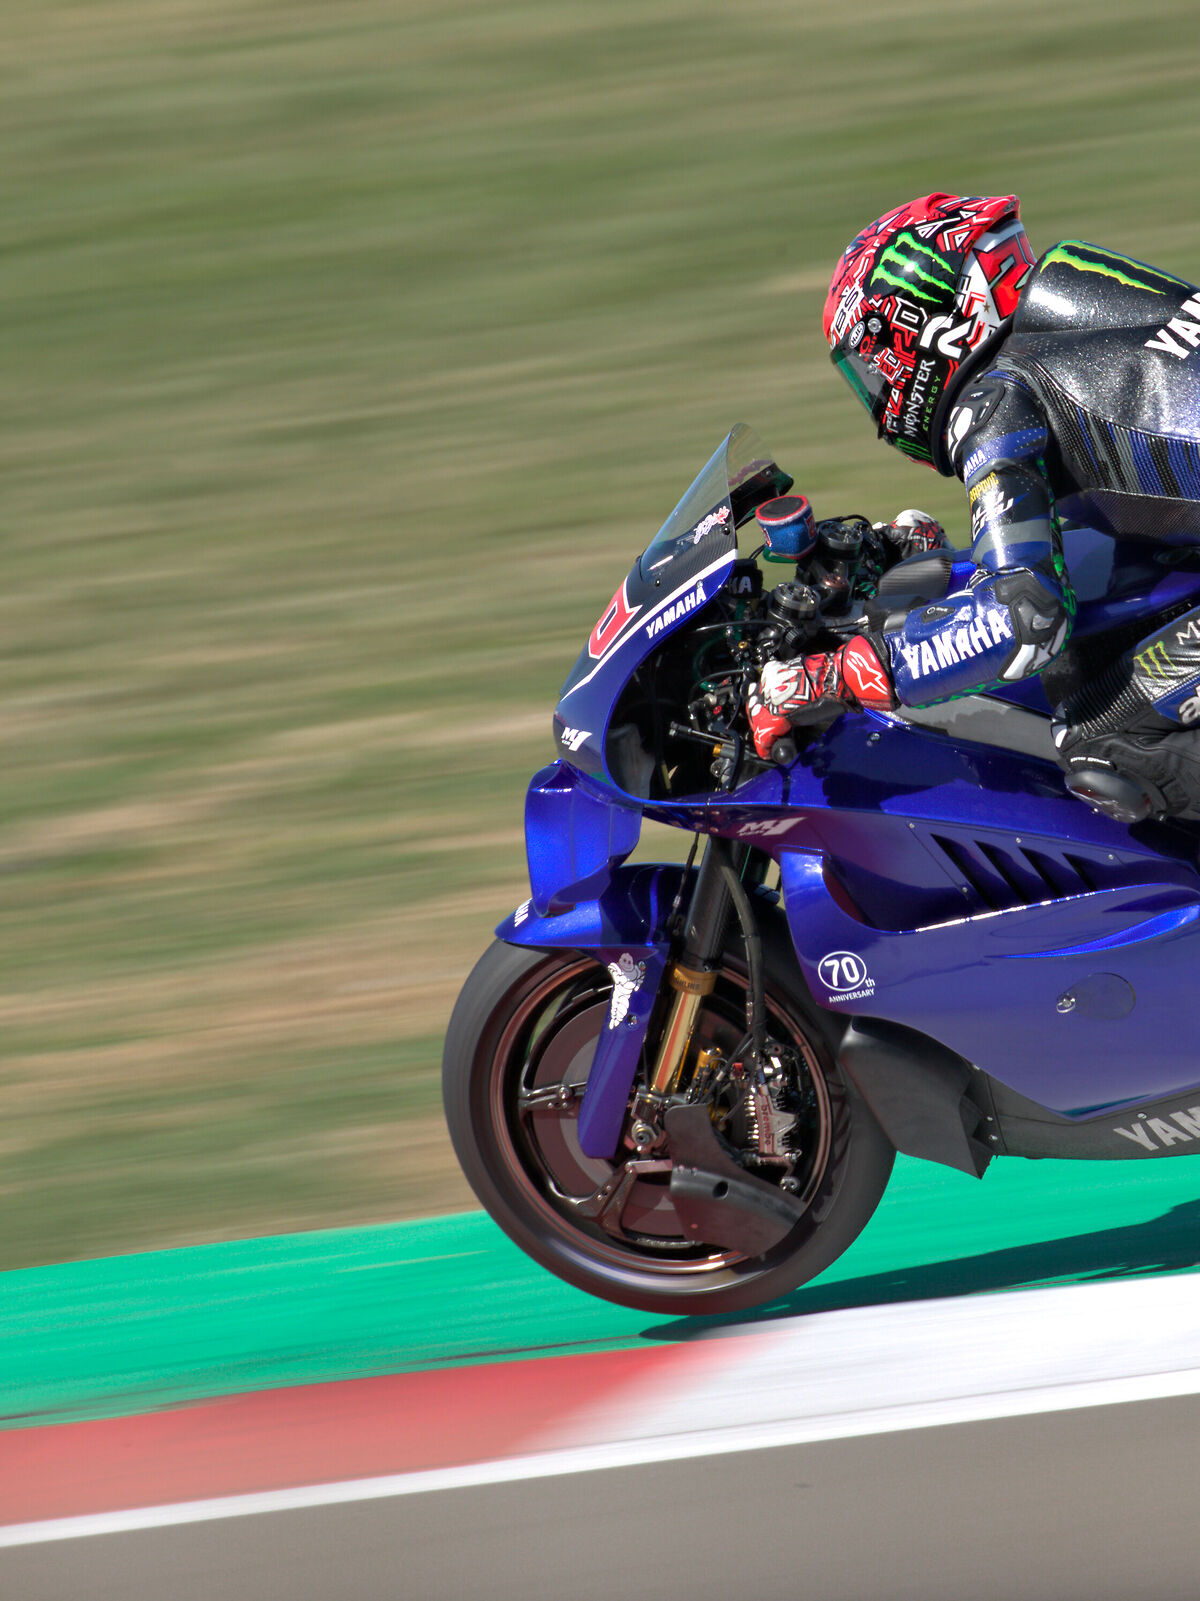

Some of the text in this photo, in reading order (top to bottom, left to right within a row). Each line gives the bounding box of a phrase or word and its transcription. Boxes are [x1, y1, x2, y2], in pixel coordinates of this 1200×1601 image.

[903, 359, 937, 438] MONSTER
[922, 376, 941, 432] ENERGY
[645, 584, 707, 639] YAMAHA
[901, 608, 1013, 680] YAMAHA
[828, 988, 875, 1004] ANNIVERSARY
